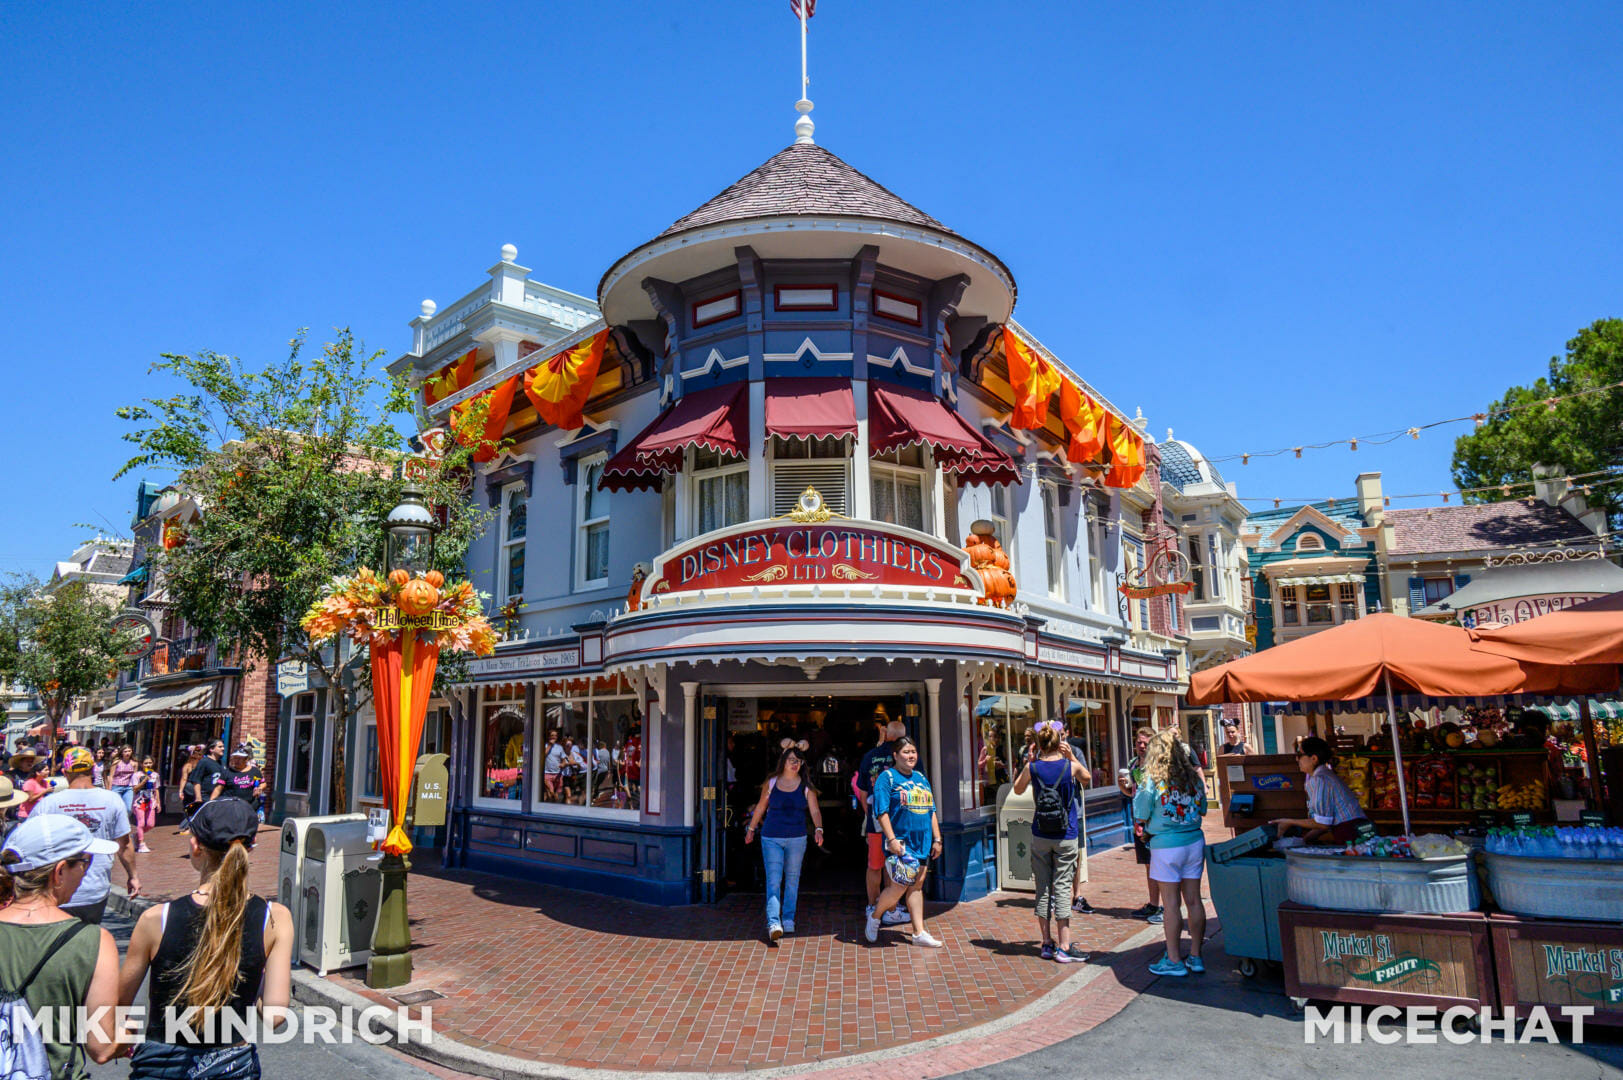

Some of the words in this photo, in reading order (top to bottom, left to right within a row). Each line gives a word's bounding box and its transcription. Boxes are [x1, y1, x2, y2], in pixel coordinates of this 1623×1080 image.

[680, 532, 779, 585] DISNEY
[785, 530, 943, 580] CLOTHIERS
[543, 654, 559, 665] Since
[421, 792, 443, 800] MAIL
[424, 782, 441, 790] U.S.
[1320, 931, 1374, 962] Market
[1376, 934, 1395, 963] St.
[1375, 958, 1418, 982] FRUIT
[1542, 944, 1608, 979] Market
